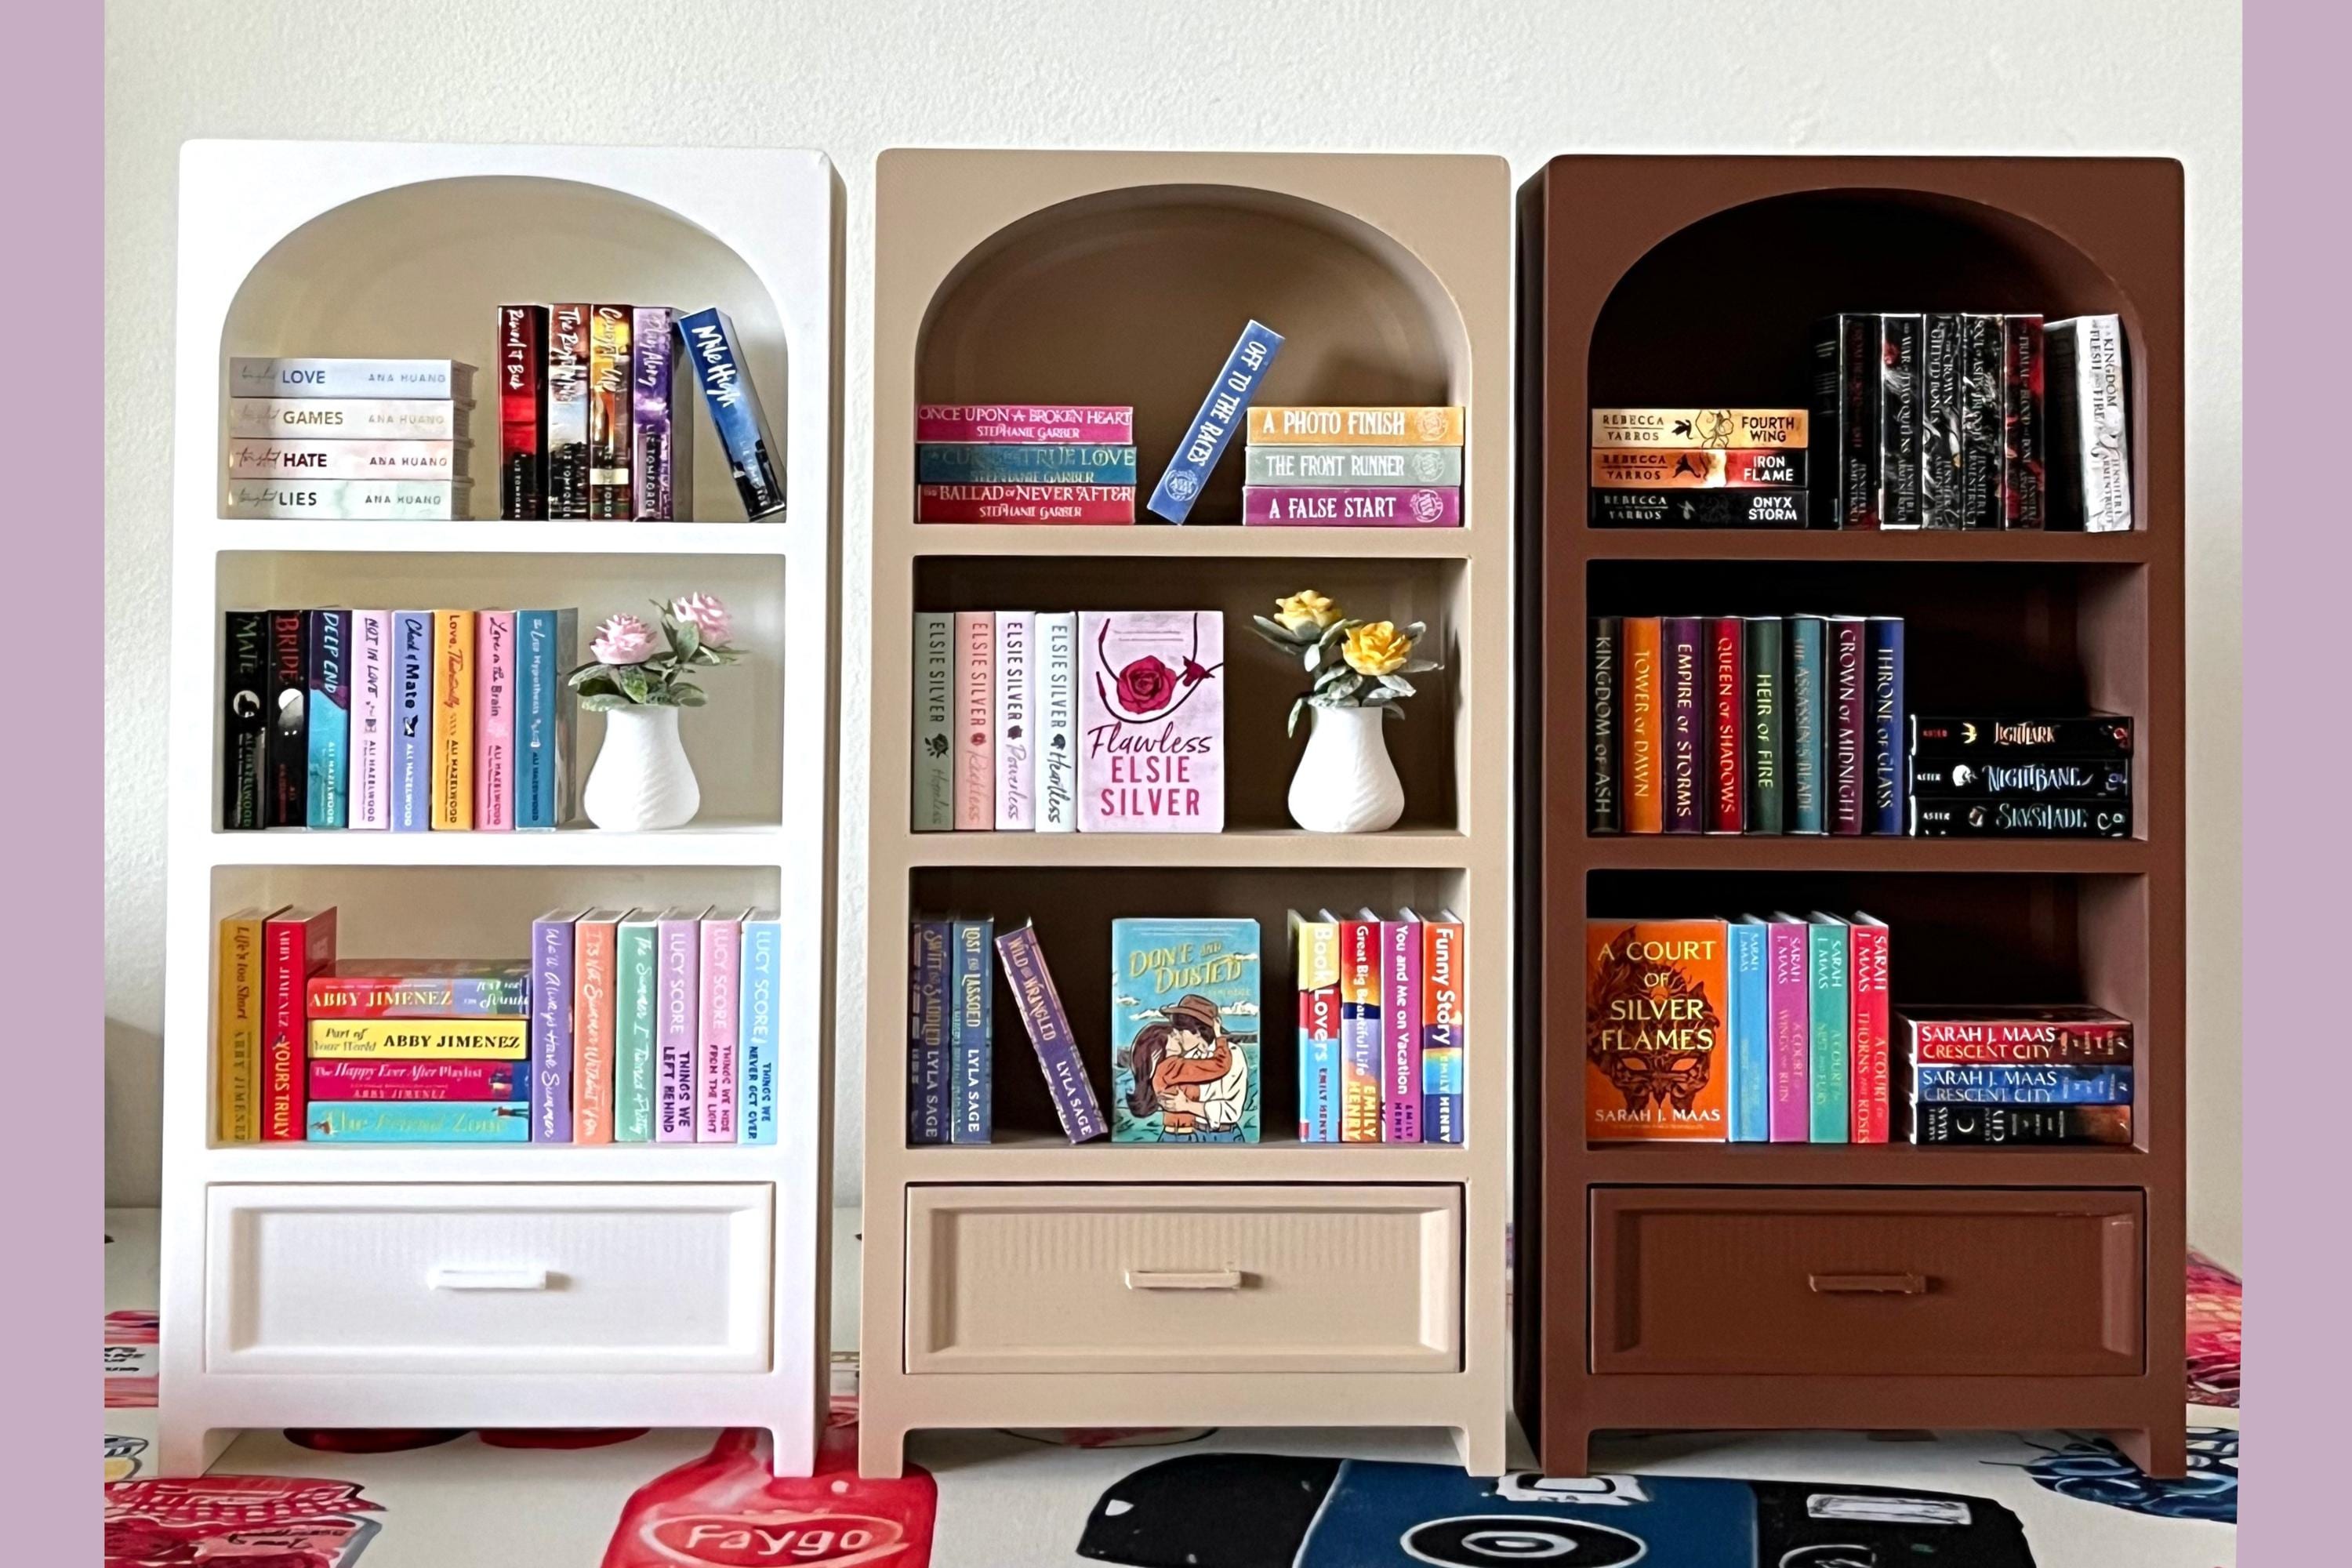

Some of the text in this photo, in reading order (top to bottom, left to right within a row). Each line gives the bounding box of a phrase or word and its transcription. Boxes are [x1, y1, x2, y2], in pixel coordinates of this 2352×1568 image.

[1240, 339, 1268, 373] OFF
[282, 371, 325, 383] LOVE
[368, 373, 394, 383] ANA
[1227, 369, 1253, 393] TO
[283, 411, 343, 425] GAMES
[918, 406, 961, 422] ONCE
[964, 406, 1010, 423] UPON
[1028, 408, 1083, 424] BROKEN
[1086, 408, 1133, 426] HEART
[1209, 391, 1241, 426] THE
[1262, 410, 1406, 436] A PHOTO FINISH
[1602, 415, 1664, 426] REBECCA
[1740, 416, 1795, 430] FOURTH
[1749, 430, 1788, 443] WING
[283, 453, 328, 467] HATE
[369, 457, 396, 466] ANA
[1265, 455, 1406, 477] THE FRONT RUNNER
[1743, 468, 1795, 482] FLAME
[1752, 456, 1786, 468] IRON
[278, 492, 318, 506] LIES
[365, 495, 390, 504] ANA
[938, 485, 1004, 502] BALLAD
[1014, 485, 1073, 502] NEVER
[1269, 497, 1397, 520] A FALSE START
[1752, 495, 1793, 510] ONYX
[1748, 508, 1798, 521] STORM
[365, 617, 379, 645] NOT
[1051, 624, 1068, 670] ELSIE
[322, 612, 339, 693] DEEP END
[367, 648, 379, 661] IN
[366, 665, 379, 699] LOVE
[404, 663, 420, 709] Mate
[929, 622, 946, 723] ELSIE SILVER
[970, 622, 989, 727] ELSIE SILVER
[1007, 622, 1023, 721] ELSIE SILVER
[1595, 637, 1611, 736] KINGDOM
[1877, 648, 1893, 723] THRONE
[490, 685, 503, 717] Brain
[1050, 673, 1068, 729] SILVER
[1757, 674, 1772, 716] HEIR
[1087, 720, 1214, 760] Flawless
[1634, 649, 1650, 798] TOWER DAWN
[1676, 644, 1693, 817] EMPIRE STORMS
[1718, 637, 1736, 814] QUEEN SHADOWS
[1838, 630, 1856, 822] CROWN MIDNIGHT
[1110, 755, 1190, 783] ELSIE
[1758, 750, 1773, 789] FIRE
[1877, 752, 1893, 809] GLASS
[1099, 788, 1200, 816] SILVER
[1595, 771, 1610, 813] ASH
[1355, 926, 1369, 961] Great
[1396, 925, 1409, 952] You
[1597, 940, 1717, 961] A COURT
[670, 932, 687, 1034] LUCY SCORE
[712, 928, 729, 1030] LUCY SCORE
[753, 930, 772, 1039] LUCY SCORE
[1154, 956, 1244, 996] DUSTED
[1396, 956, 1409, 982] and
[1643, 972, 1669, 988] OF
[309, 991, 453, 1007] ABBY JIMENEZ
[1313, 927, 1334, 1062] Book Lovers
[1432, 927, 1457, 1046] Funny Story
[1610, 998, 1704, 1021] SILVER
[383, 1035, 521, 1049] ABBY JIMENEZ
[1601, 1028, 1714, 1051] FLAMES
[1921, 1026, 2056, 1043] SARAH MAAS
[662, 1046, 676, 1079] LEFT
[967, 1049, 980, 1087] LYLA
[1396, 1033, 1409, 1094] Vacation
[1922, 1044, 2053, 1059] CRESCENT CITY
[333, 1062, 377, 1081] Happy
[1922, 1070, 1983, 1086] SARAH
[2003, 1071, 2057, 1086] MAAS
[678, 1050, 691, 1127] THINGS WE
[925, 1051, 939, 1138] LYLA SAGE
[1056, 1060, 1093, 1136] LYLA SAGE
[1923, 1087, 2055, 1103] CRESCENT CITY
[967, 1091, 980, 1134] SAGE
[1362, 1085, 1377, 1136] EMILY
[1594, 1109, 1652, 1122] SARAH
[1671, 1109, 1722, 1122] MAAS
[684, 1523, 874, 1556] Faygo
